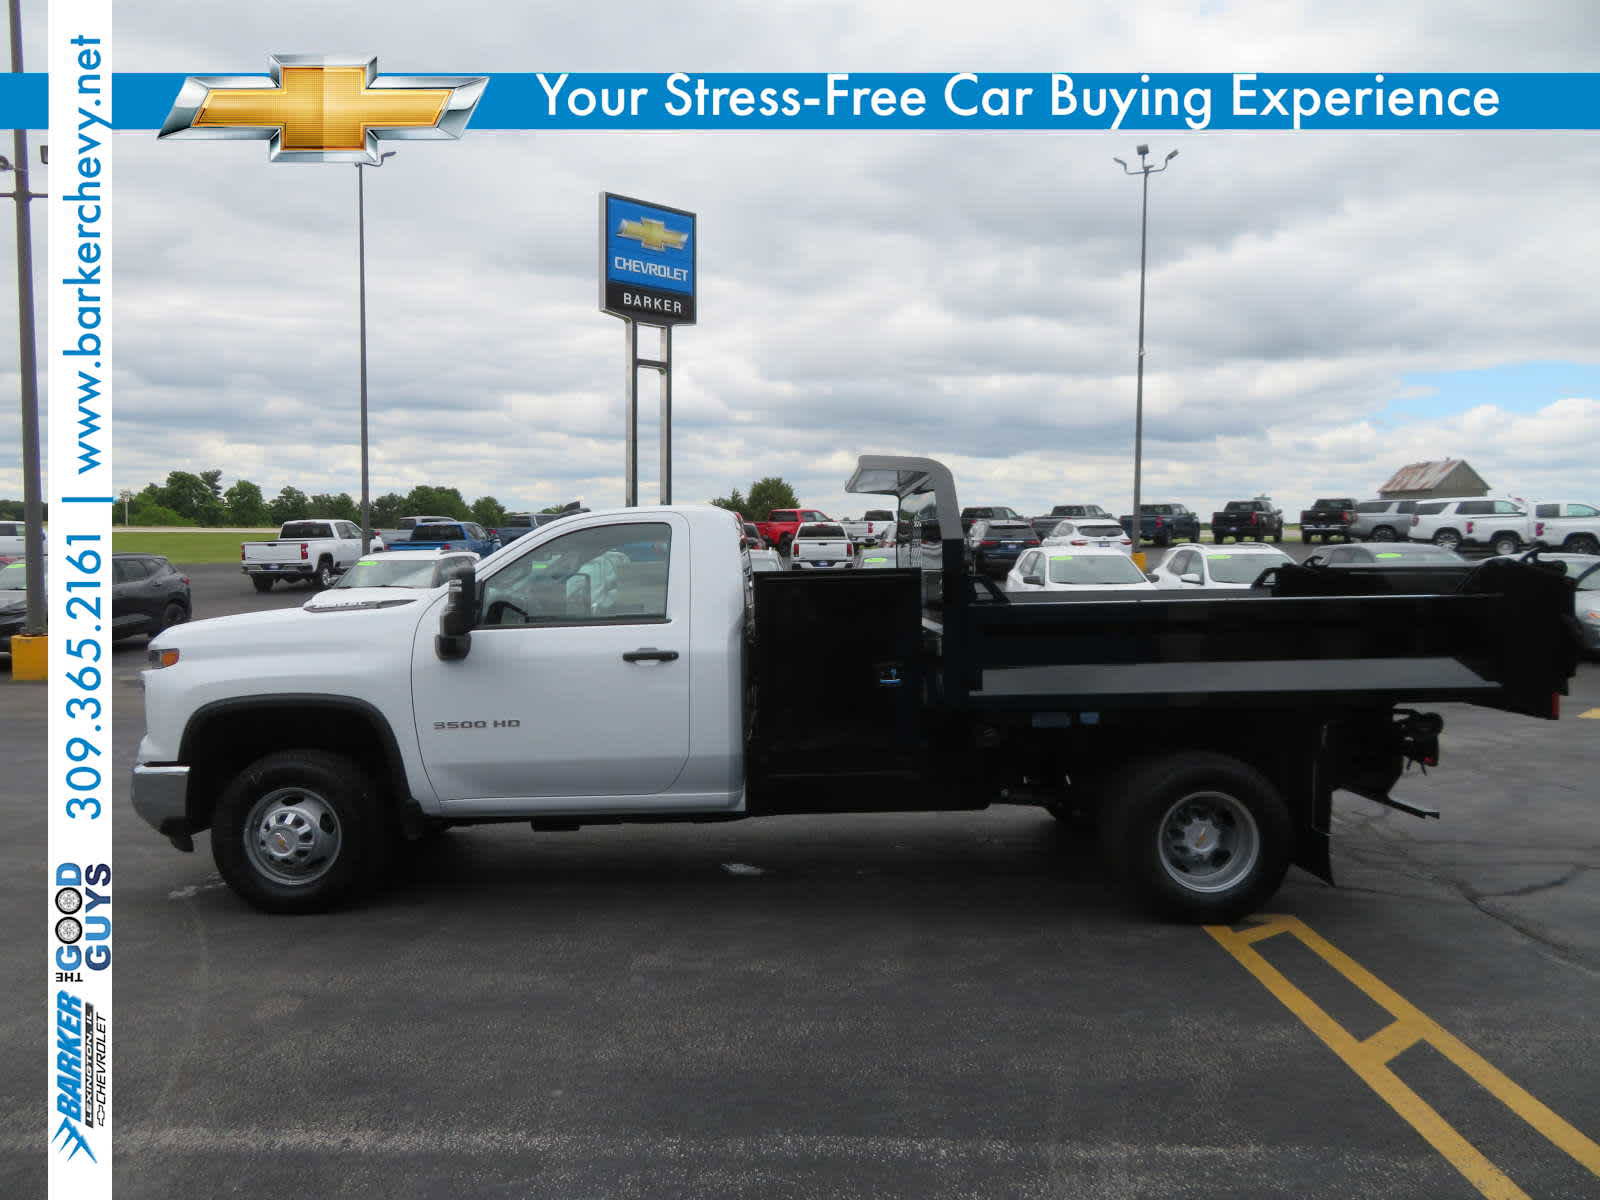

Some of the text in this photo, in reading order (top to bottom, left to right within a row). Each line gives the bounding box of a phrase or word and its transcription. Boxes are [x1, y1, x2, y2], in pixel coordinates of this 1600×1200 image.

[614, 256, 688, 281] CHEVROLET
[623, 292, 682, 313] BARKER
[433, 719, 521, 730] 3500 HD
